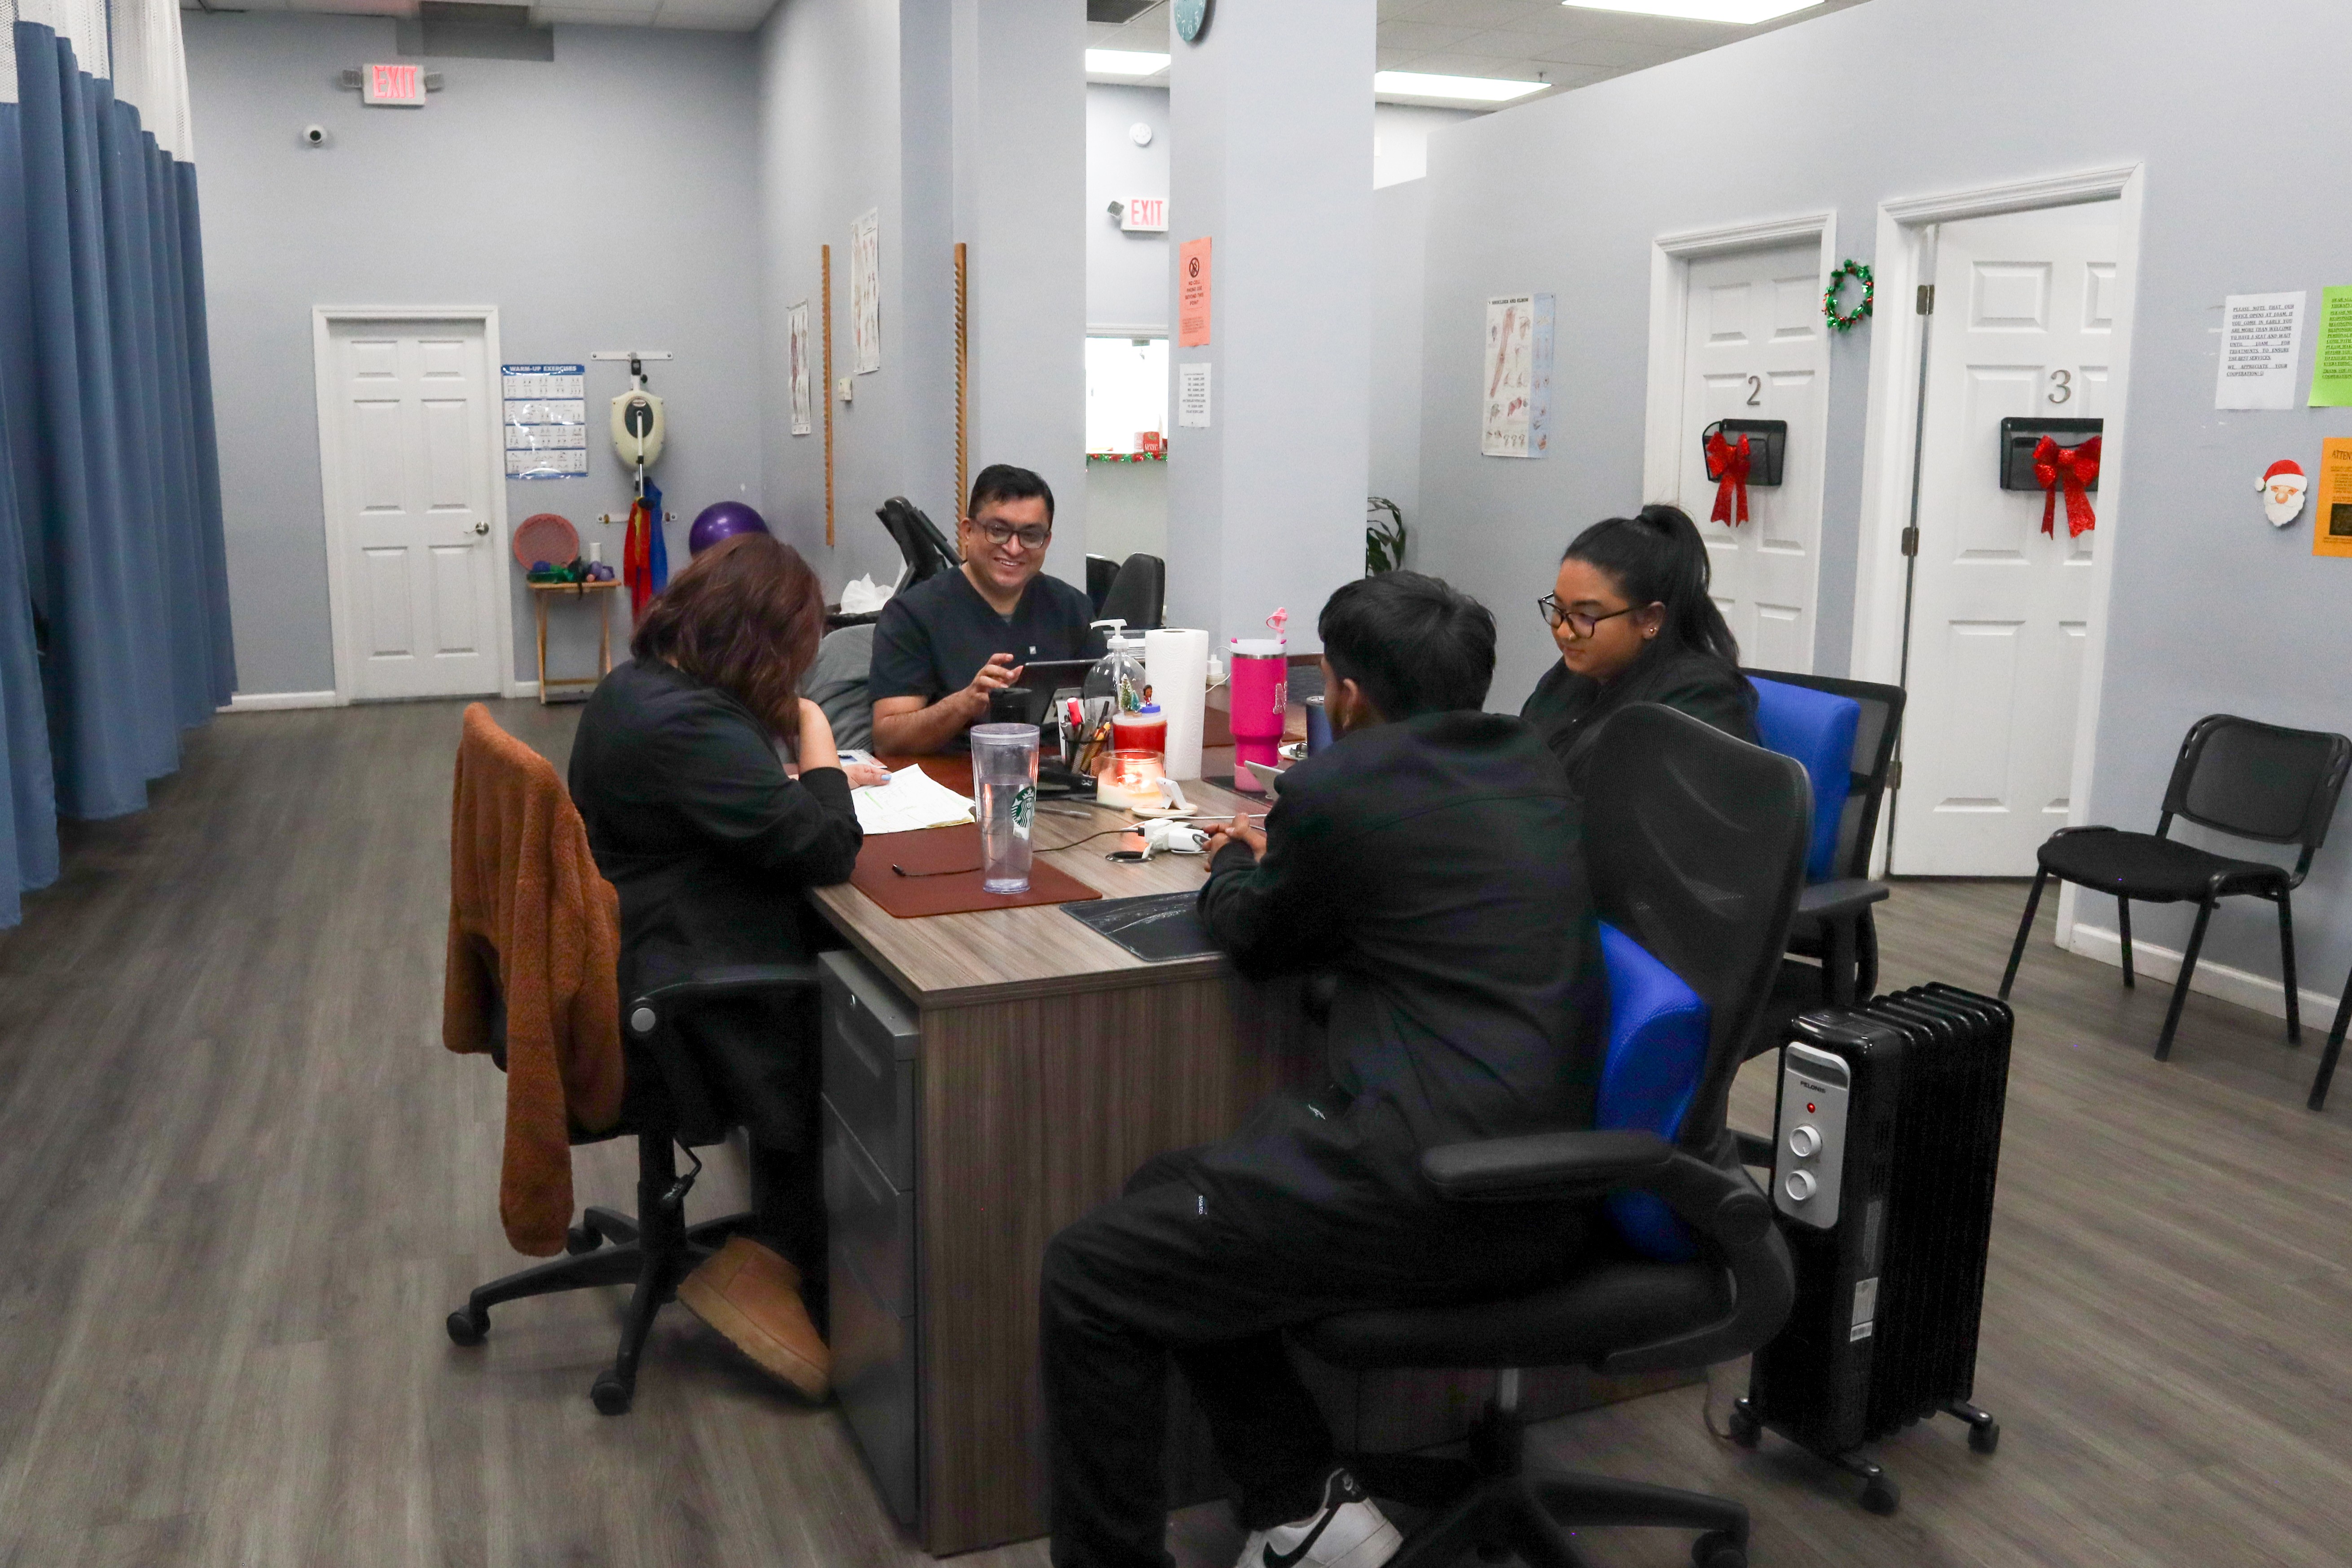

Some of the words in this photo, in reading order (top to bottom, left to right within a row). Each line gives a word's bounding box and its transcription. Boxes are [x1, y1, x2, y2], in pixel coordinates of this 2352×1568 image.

[1182, 19, 1185, 33] 7
[1194, 11, 1199, 25] 5
[372, 66, 418, 99] EXIT
[1131, 199, 1163, 226] EXIT
[1746, 375, 1762, 406] 2
[2048, 369, 2072, 404] 3
[1800, 1081, 1826, 1094] PELONIS
